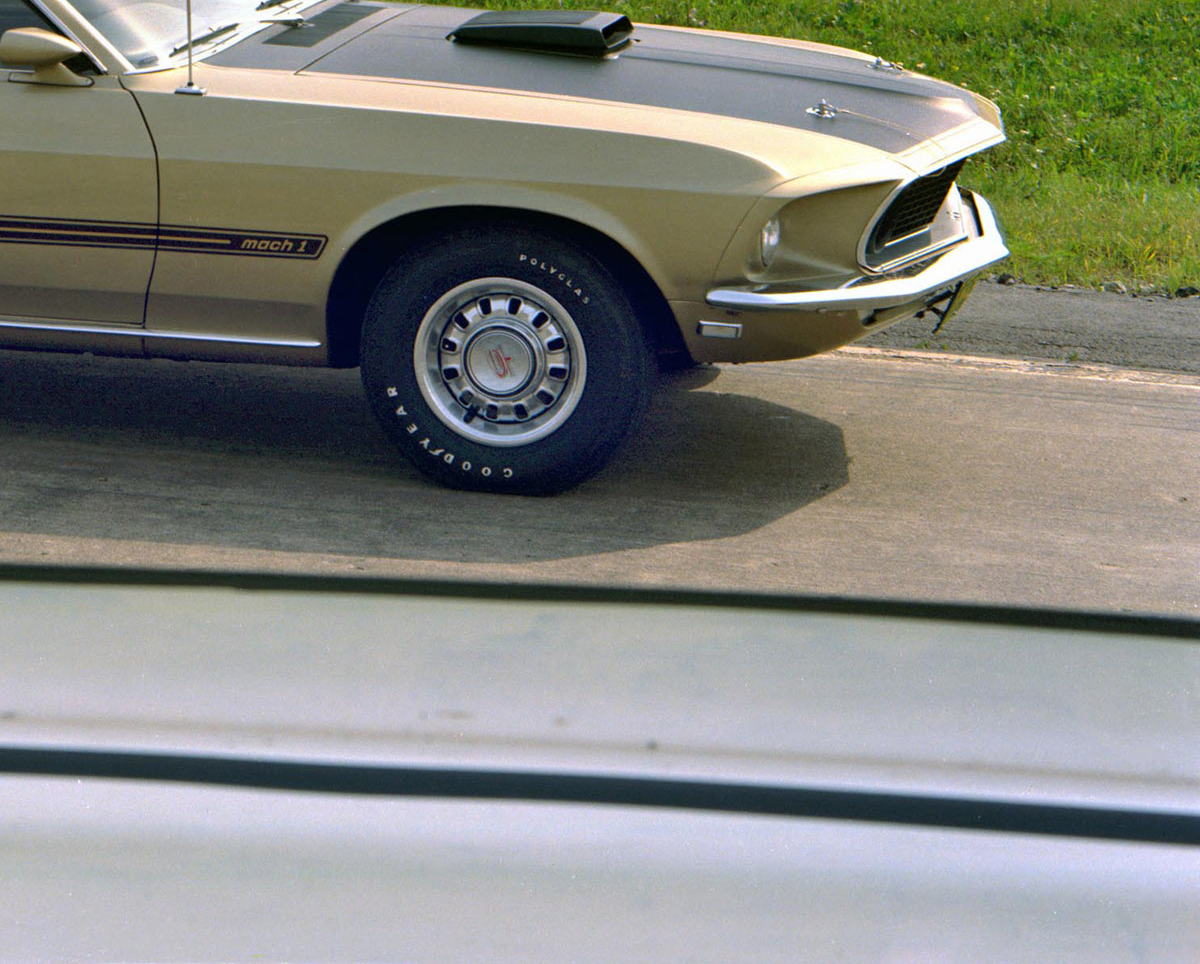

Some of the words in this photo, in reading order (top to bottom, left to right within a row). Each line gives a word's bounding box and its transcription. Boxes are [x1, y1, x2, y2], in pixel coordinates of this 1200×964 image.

[241, 239, 293, 252] mach
[297, 240, 308, 252] 1
[386, 386, 513, 478] GOODYEAR
